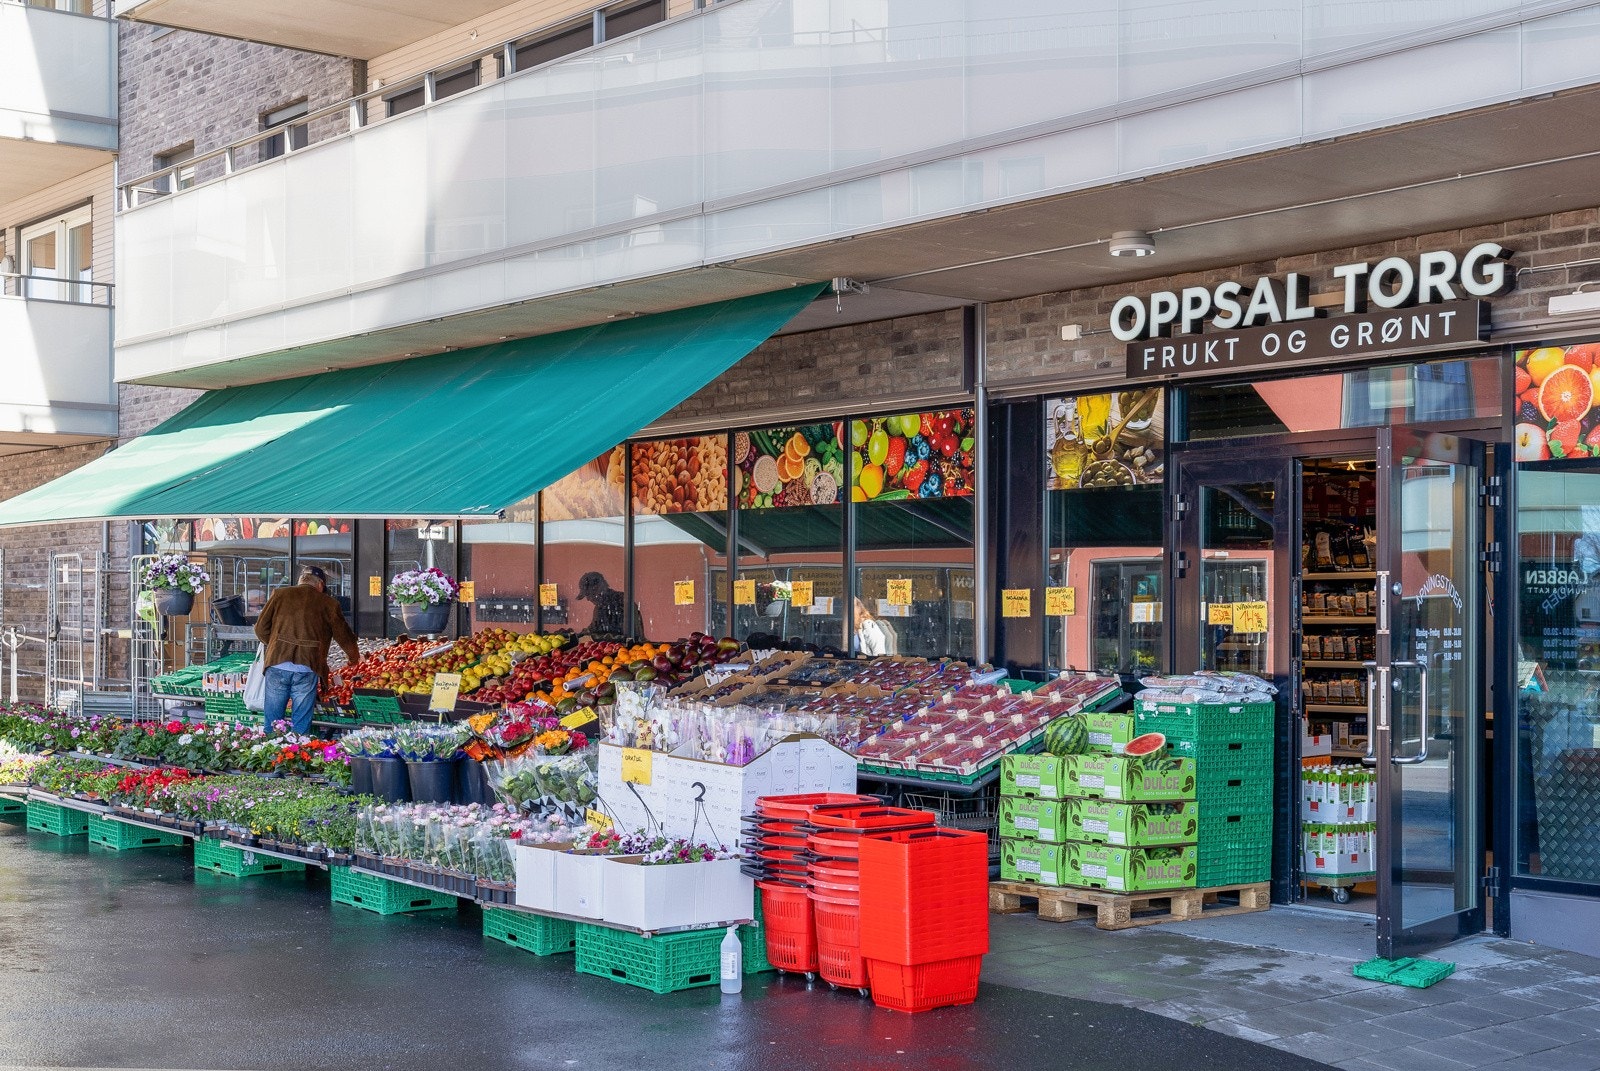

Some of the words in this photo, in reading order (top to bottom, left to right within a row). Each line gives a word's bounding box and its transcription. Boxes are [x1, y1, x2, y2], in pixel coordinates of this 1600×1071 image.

[1109, 273, 1316, 341] OPPSAL
[1334, 242, 1506, 314] TORG
[1143, 337, 1241, 370] FRUKT
[1261, 329, 1307, 357] OG
[1330, 310, 1458, 349] GRØNT
[1093, 720, 1113, 728] DULCE
[1020, 762, 1040, 770] DULCE
[1085, 762, 1105, 770] DULCE
[1143, 776, 1180, 791] DULCE
[1019, 804, 1039, 812] DULCE
[1088, 806, 1109, 815] DULCE
[1147, 821, 1182, 835] DULCE
[1020, 847, 1041, 855] DULCE
[1086, 851, 1107, 860] DULCE
[1146, 865, 1182, 880] DULCE
